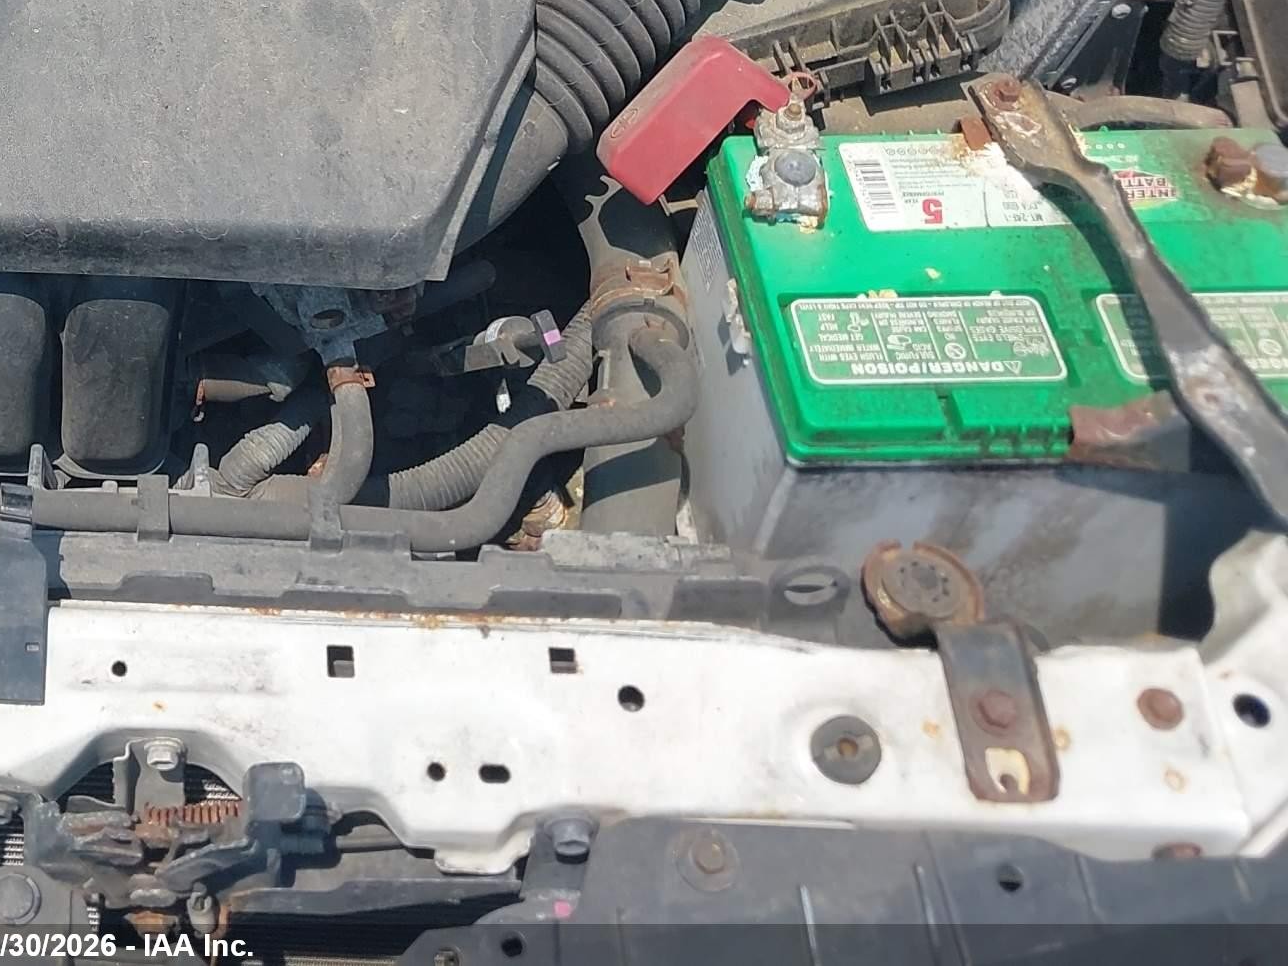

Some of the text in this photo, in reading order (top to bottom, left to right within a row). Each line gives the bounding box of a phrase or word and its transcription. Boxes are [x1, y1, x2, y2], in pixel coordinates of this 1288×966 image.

[922, 198, 943, 225] 5
[818, 313, 835, 321] FAST
[821, 323, 839, 331] HELP
[851, 361, 1004, 375] DANGER/POISON
